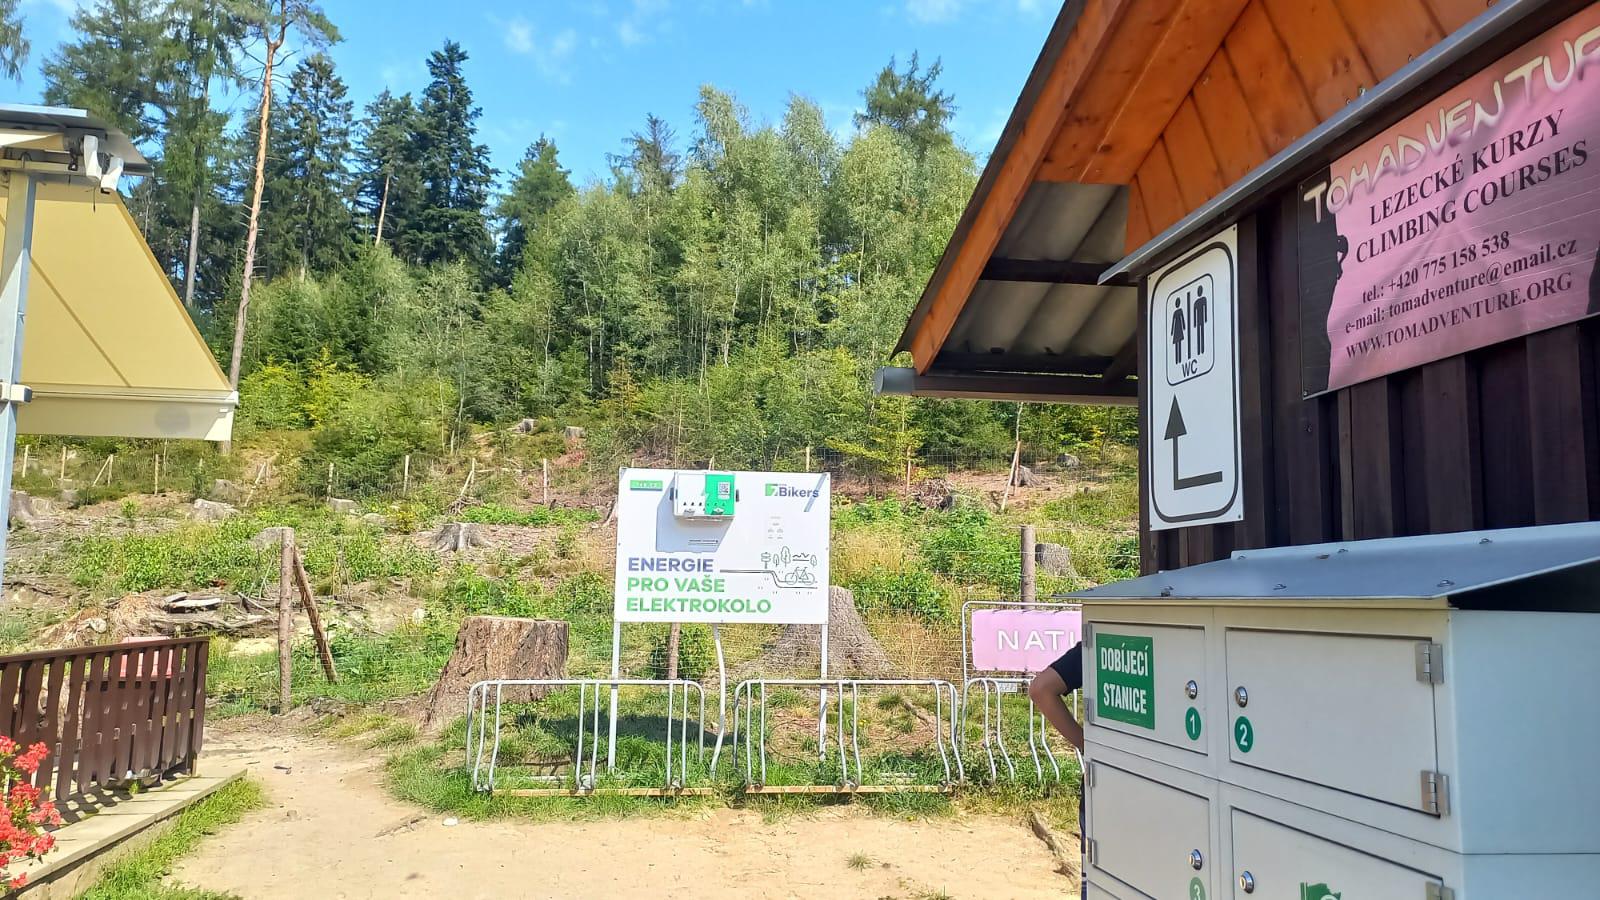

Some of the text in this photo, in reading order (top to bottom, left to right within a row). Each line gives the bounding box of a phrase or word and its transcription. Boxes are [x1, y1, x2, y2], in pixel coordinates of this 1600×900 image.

[1369, 108, 1565, 225] LEZECKÉ KURZY
[1356, 139, 1589, 263] CLIMBING COURSES
[1362, 230, 1511, 304] tel.: +420 775 158 538
[1345, 239, 1577, 334] e-mail: tomadventure@email.cz
[1346, 271, 1573, 359] WWW.TOMADVENTURE.ORG
[1182, 359, 1197, 378] WC
[779, 486, 820, 498] Bikers
[628, 557, 714, 573] ENERGIE
[627, 575, 726, 593] PRO VAŠE
[626, 597, 772, 614] ELEKTROKOLO
[1100, 642, 1149, 677] DOBÍJECÍ
[1103, 682, 1147, 715] STANICE
[1189, 713, 1196, 735] 1
[1239, 723, 1249, 746] 2
[1192, 883, 1202, 900] 3
